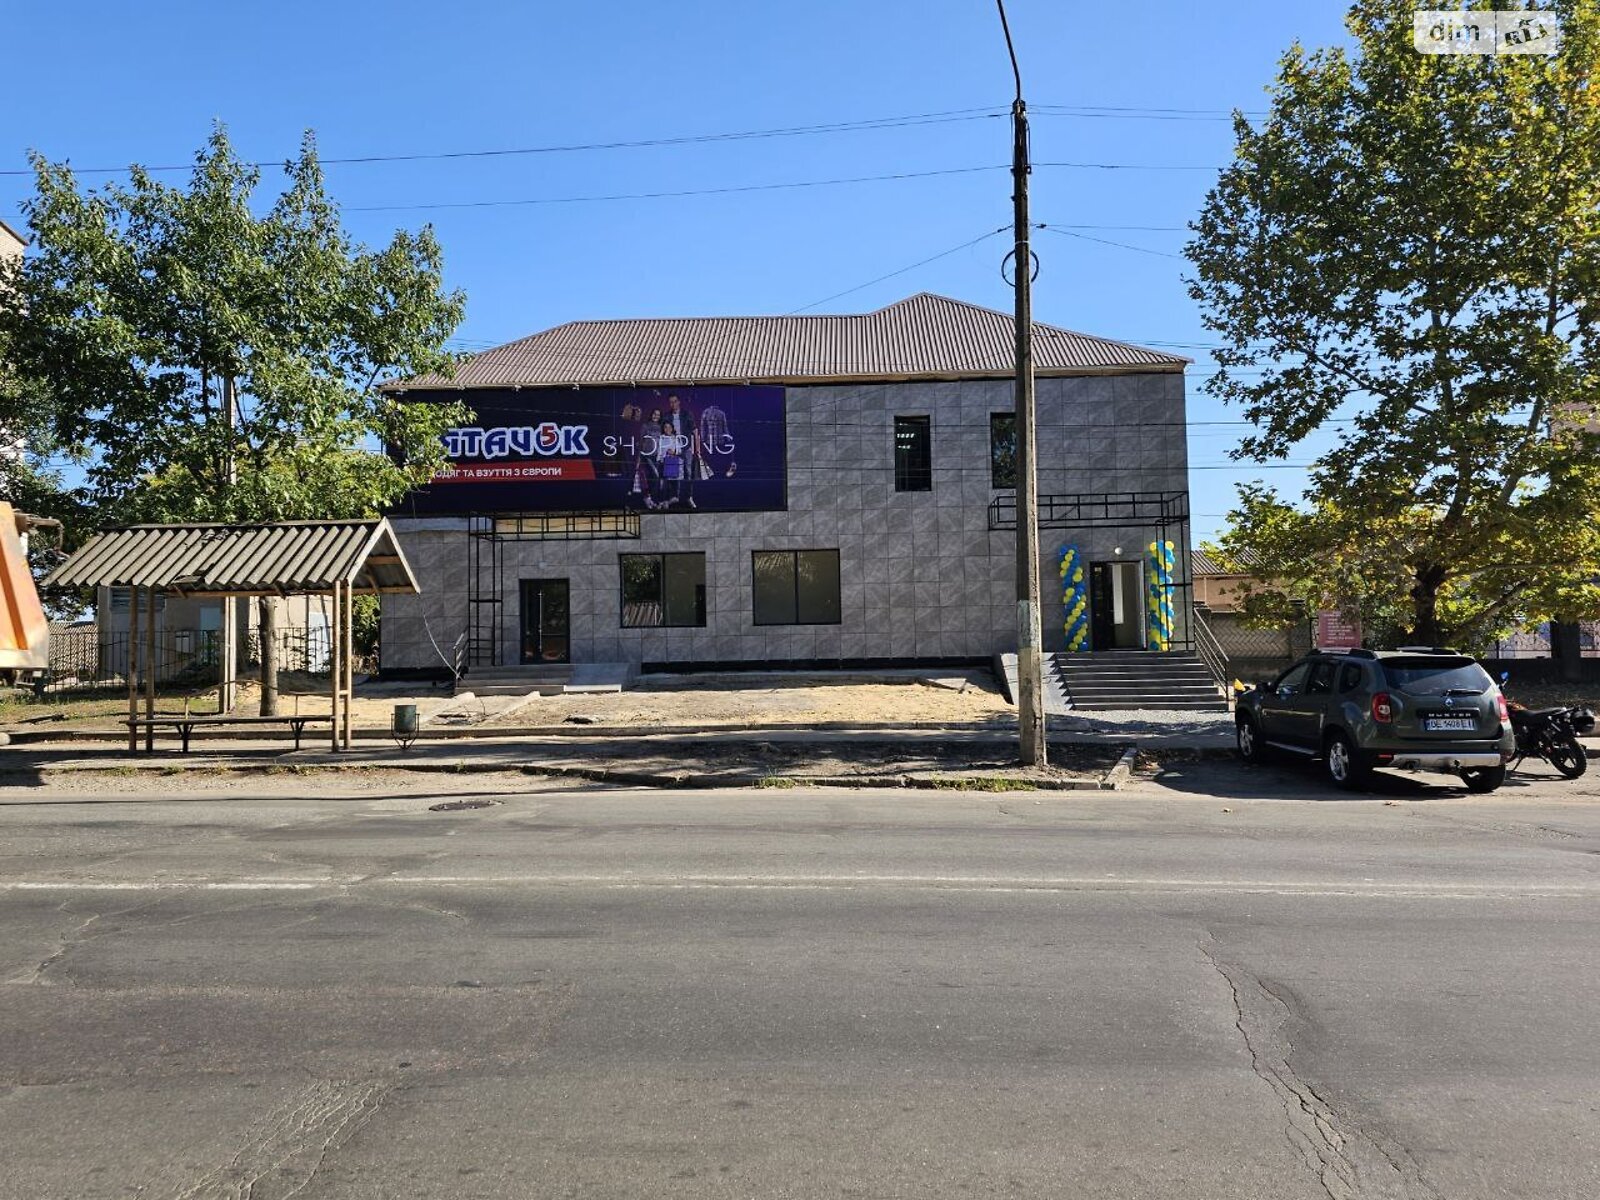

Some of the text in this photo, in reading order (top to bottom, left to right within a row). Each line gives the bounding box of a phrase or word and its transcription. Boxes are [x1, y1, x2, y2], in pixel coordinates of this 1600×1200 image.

[603, 434, 735, 456] SHOPPING
[463, 468, 475, 478] ТА
[476, 468, 512, 478] ВЗУТТЯ
[522, 467, 562, 476] ЄВРОПИ
